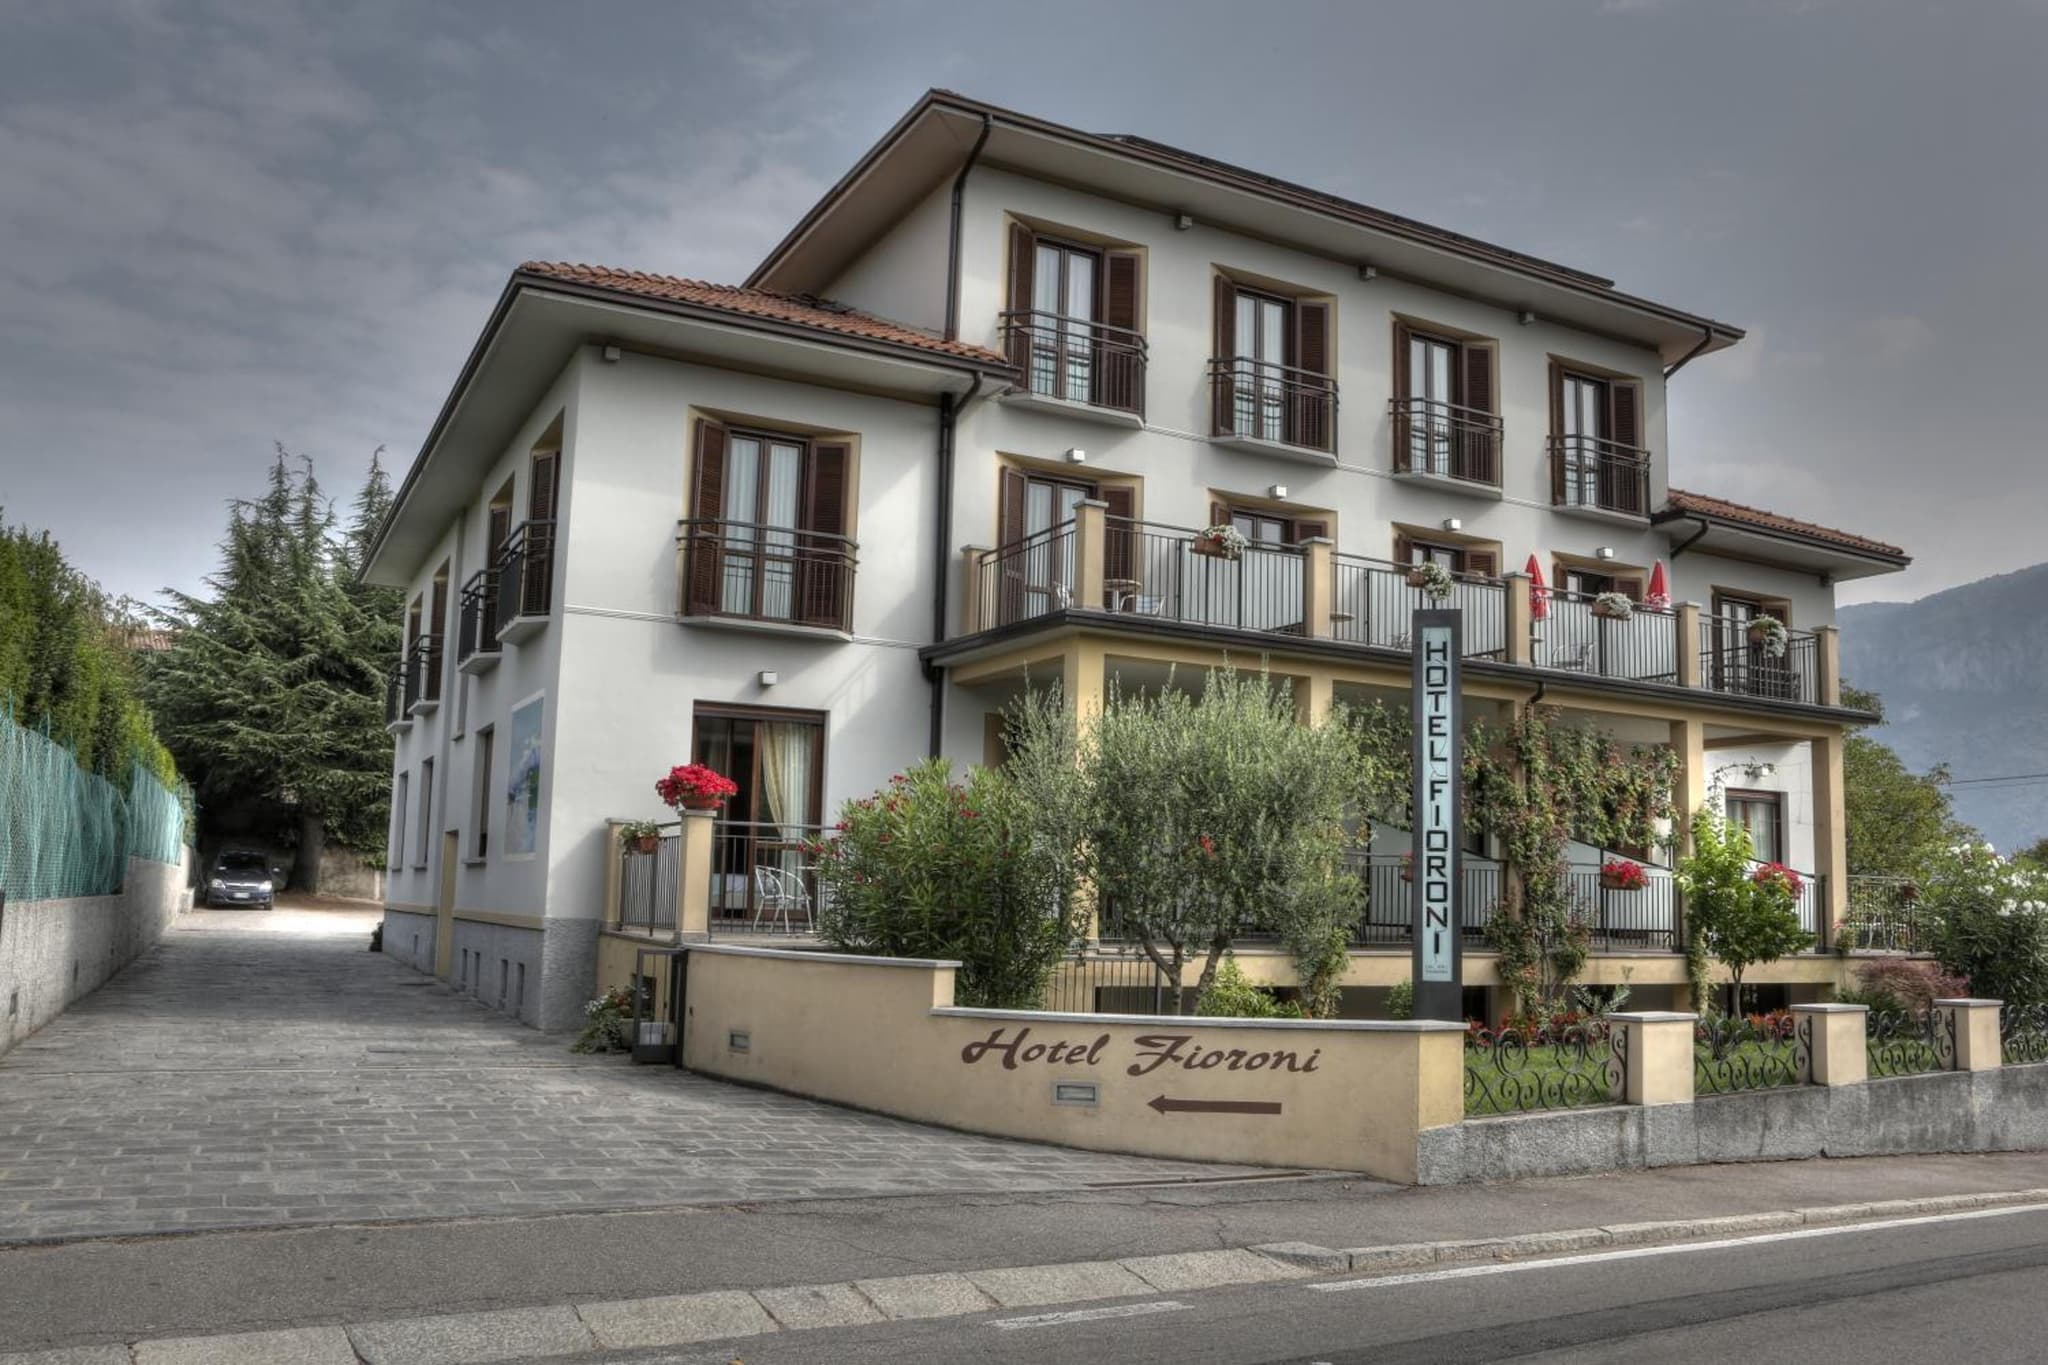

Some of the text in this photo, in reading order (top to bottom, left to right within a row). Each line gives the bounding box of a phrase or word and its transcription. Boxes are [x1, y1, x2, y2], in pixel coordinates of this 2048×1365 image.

[1425, 641, 1448, 762] HOTEL
[1425, 780, 1448, 954] FIORONI
[961, 1027, 1322, 1076] Hotel Fioroni
